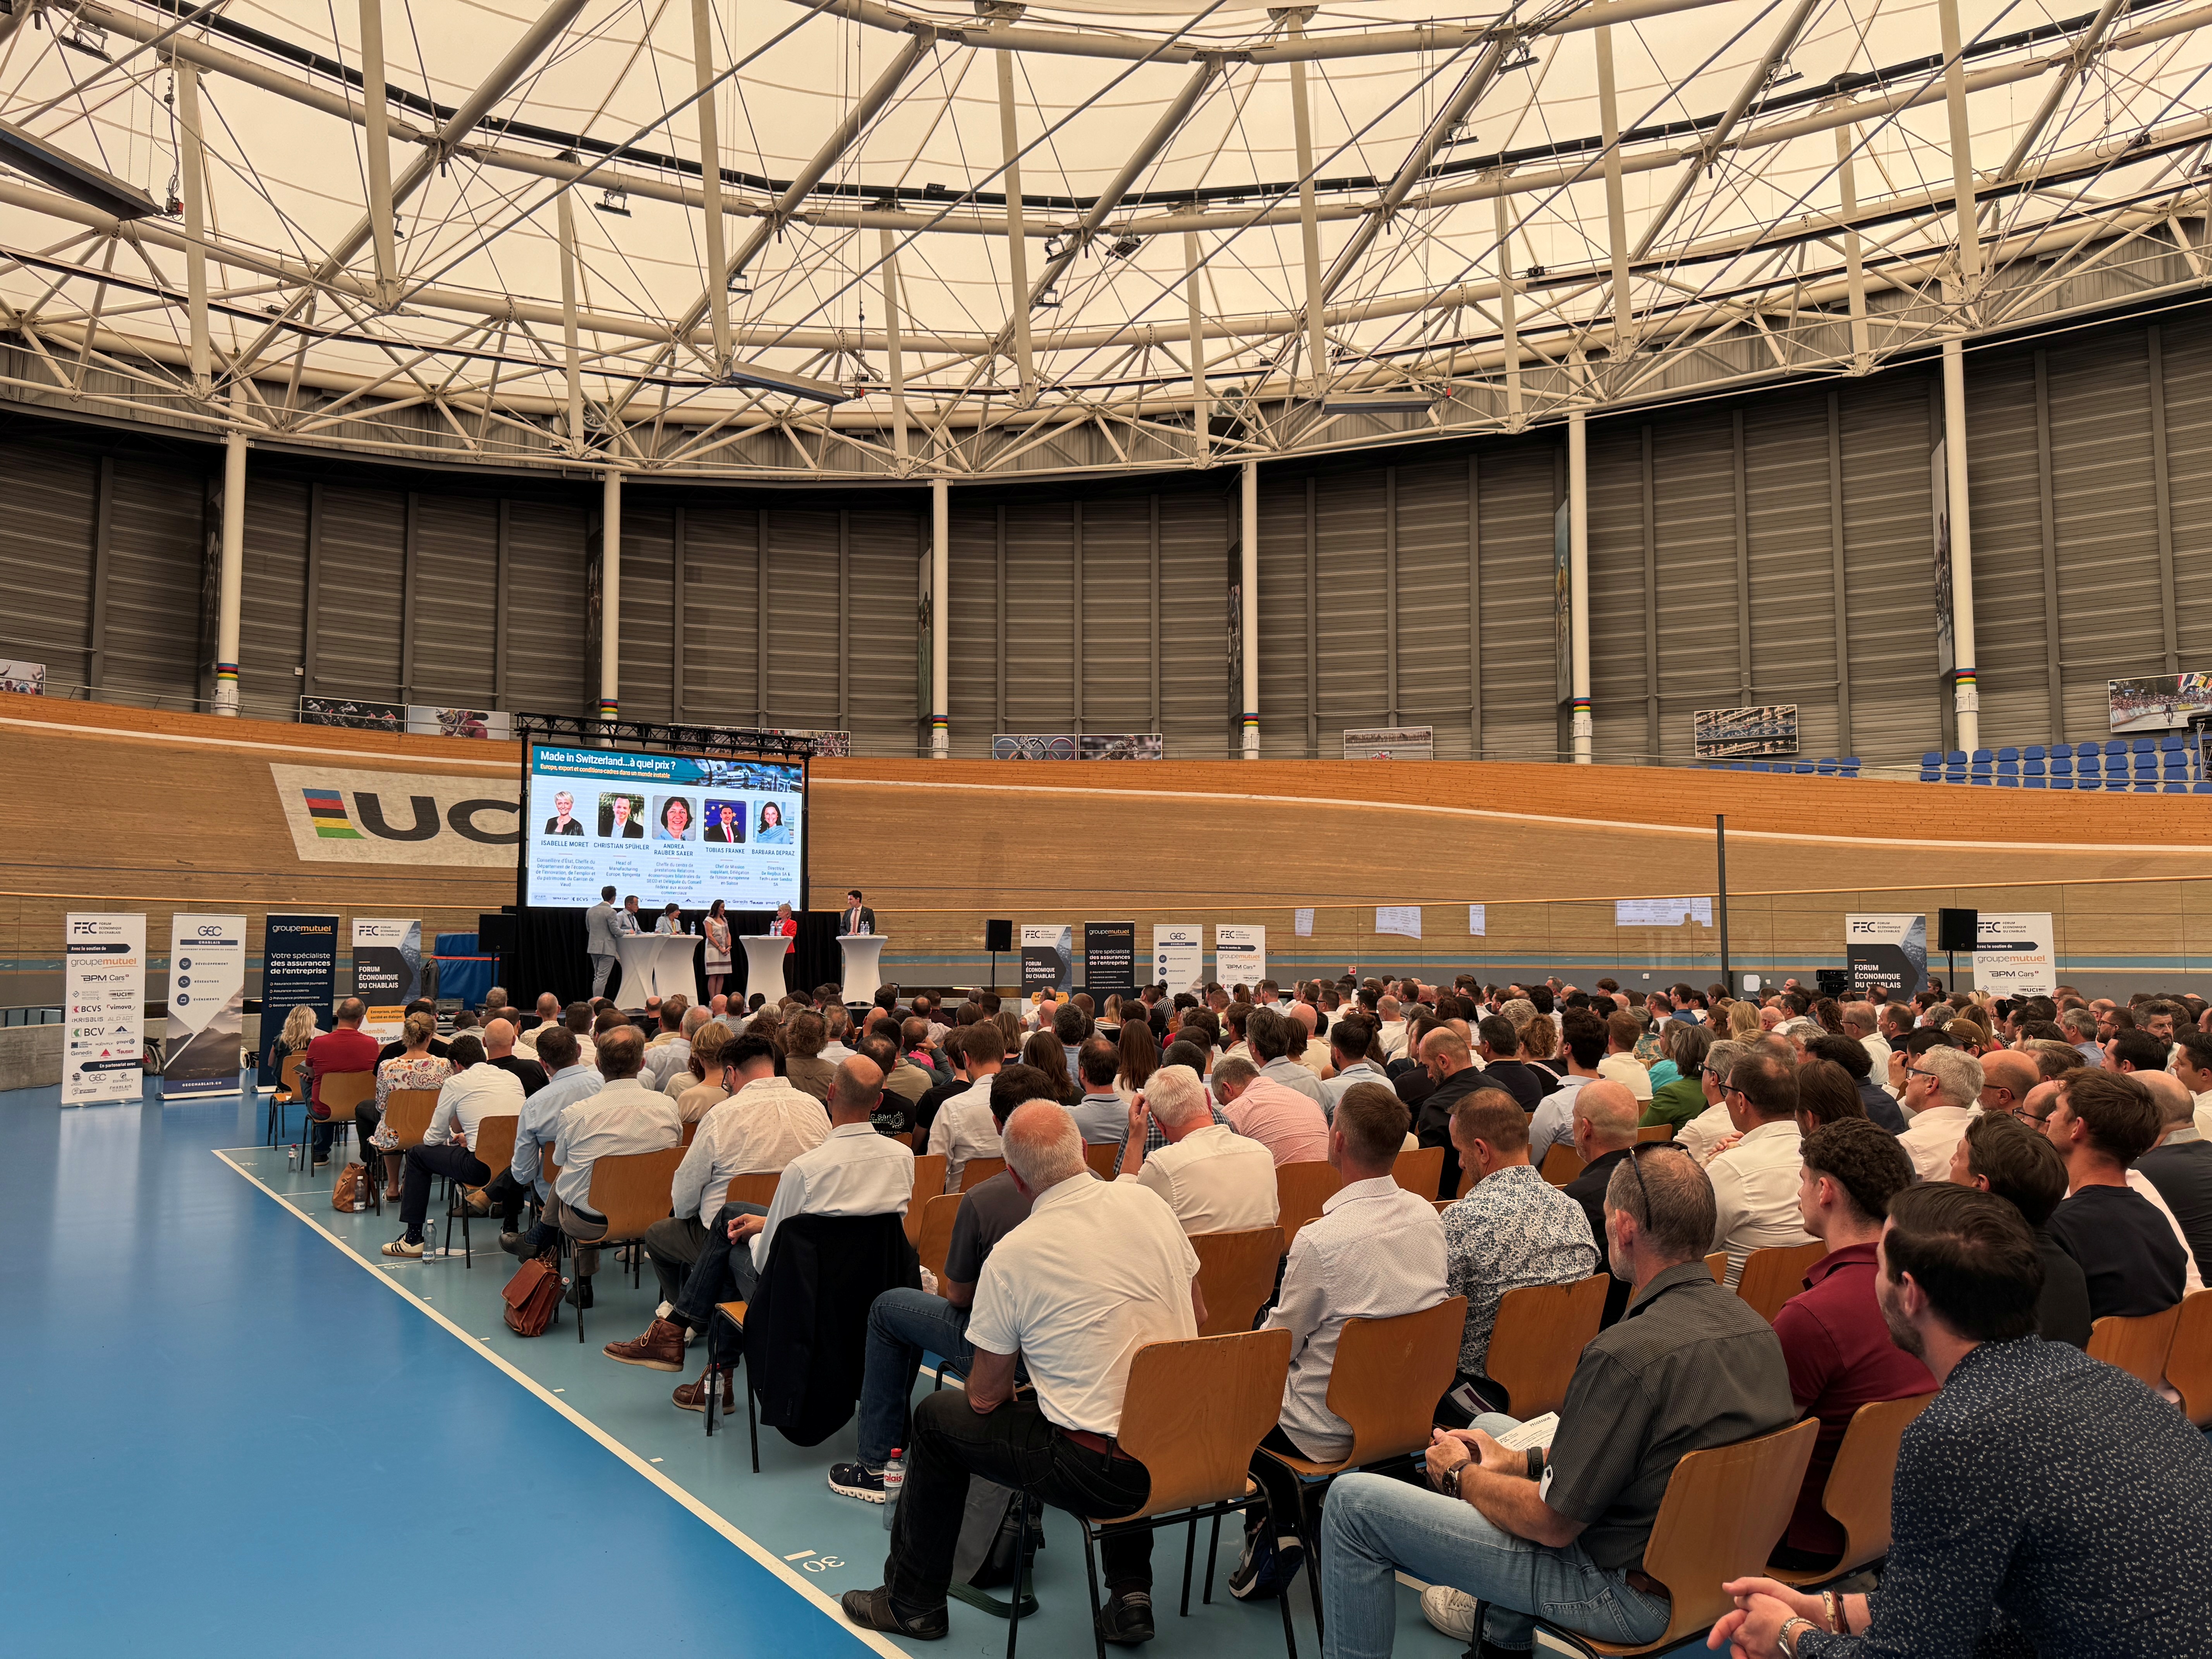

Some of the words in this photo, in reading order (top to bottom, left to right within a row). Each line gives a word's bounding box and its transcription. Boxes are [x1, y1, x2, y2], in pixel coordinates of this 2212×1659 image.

[541, 751, 565, 761] Made
[567, 753, 574, 762] in
[637, 759, 653, 769] quel
[655, 761, 670, 771] prix
[671, 761, 676, 770] ?
[74, 922, 97, 934] FEC
[198, 926, 222, 936] GEC
[359, 926, 379, 936] FEC
[1853, 922, 1876, 933] FEC
[1977, 922, 2001, 933] FEC
[1025, 930, 1040, 938] FEC
[71, 958, 137, 967] groupemutuel
[1978, 955, 2045, 963] groupemutuel
[1855, 972, 1901, 981] ÉCONOMIQUE
[84, 1027, 105, 1036] BCV
[89, 1073, 106, 1082] GEC
